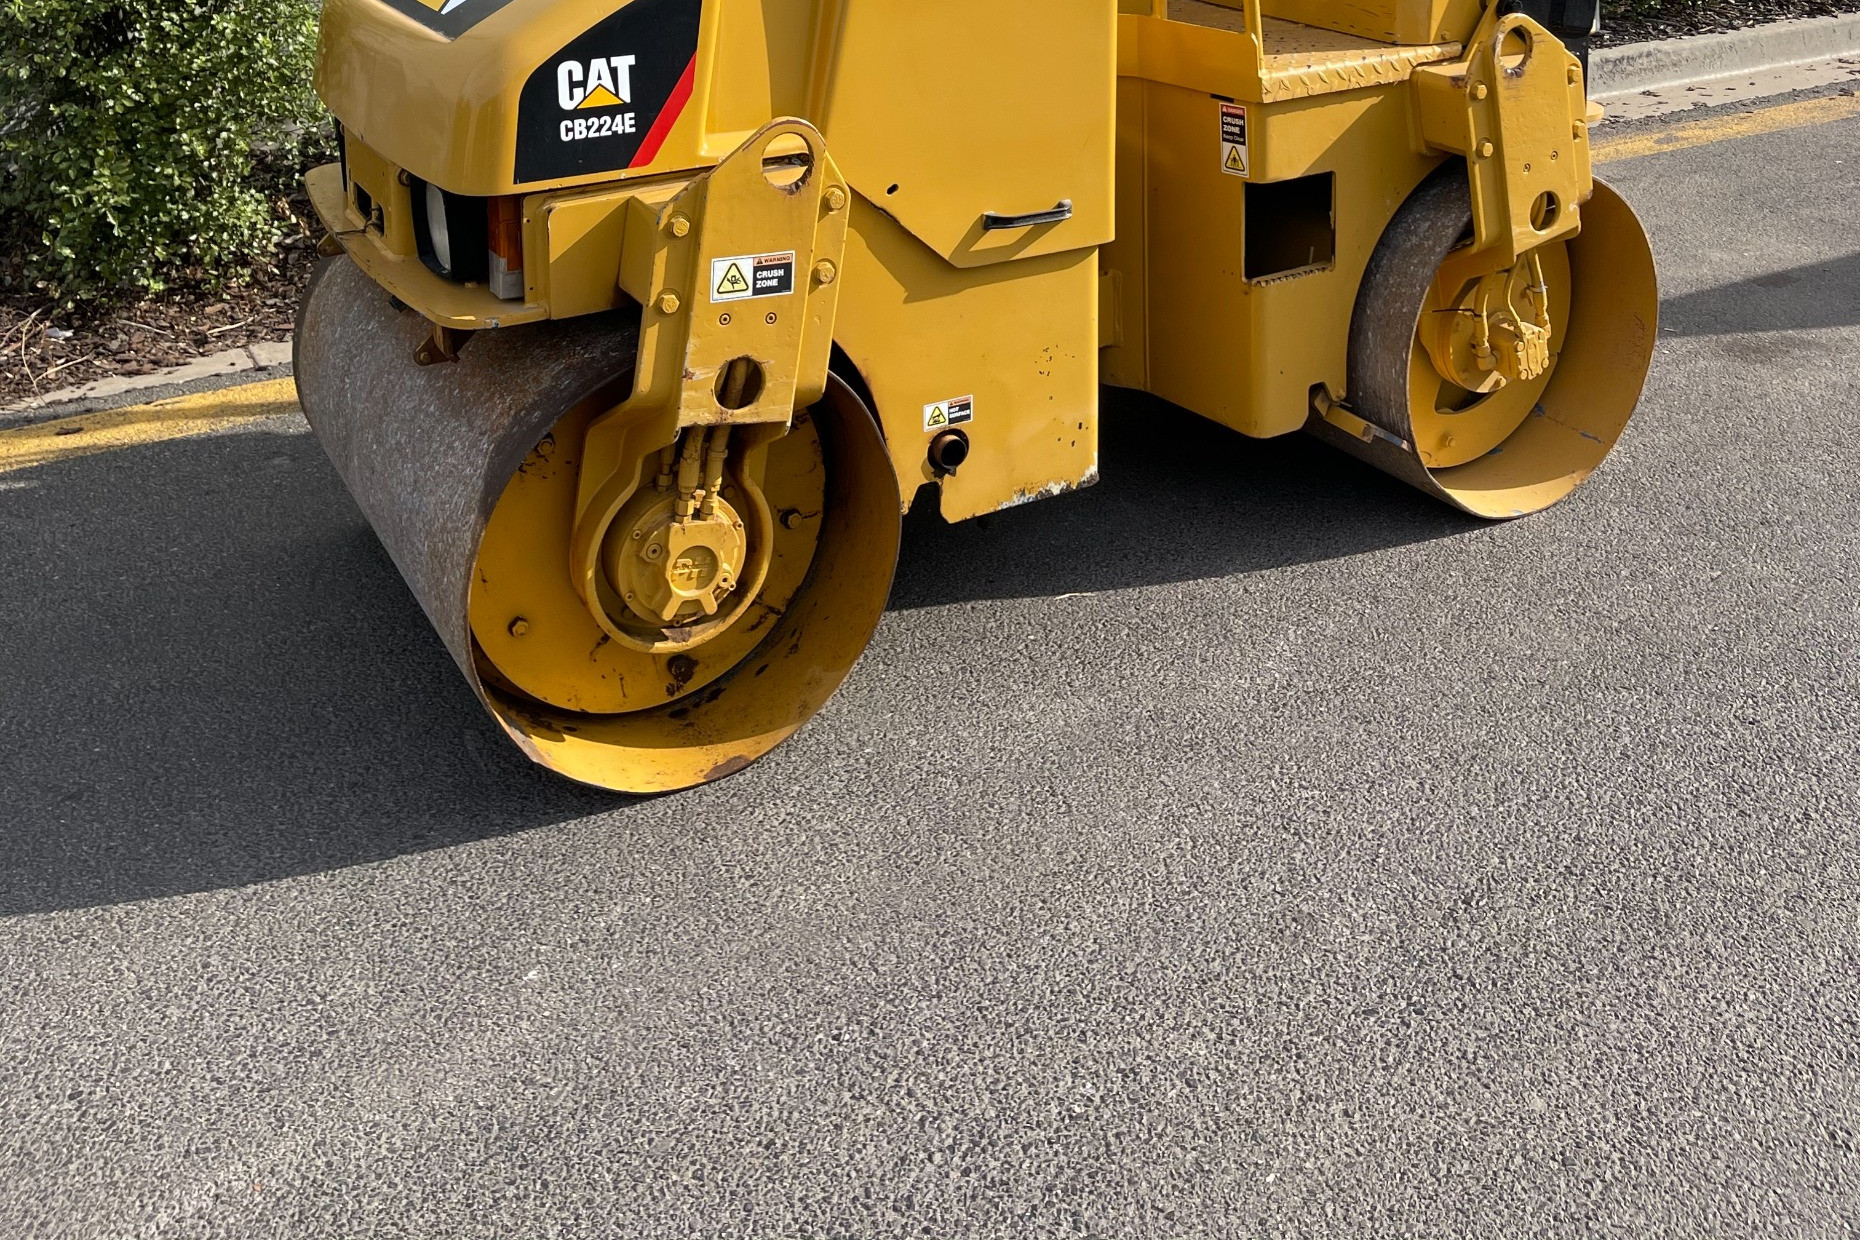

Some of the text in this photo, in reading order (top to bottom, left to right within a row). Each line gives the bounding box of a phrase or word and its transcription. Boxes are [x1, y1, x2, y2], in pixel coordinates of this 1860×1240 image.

[557, 54, 636, 111] CAT
[1222, 116, 1244, 126] CRUSH
[559, 112, 636, 142] CB224E
[1222, 124, 1240, 134] ZONE
[756, 269, 784, 279] CRUSH
[756, 279, 778, 288] ZONE
